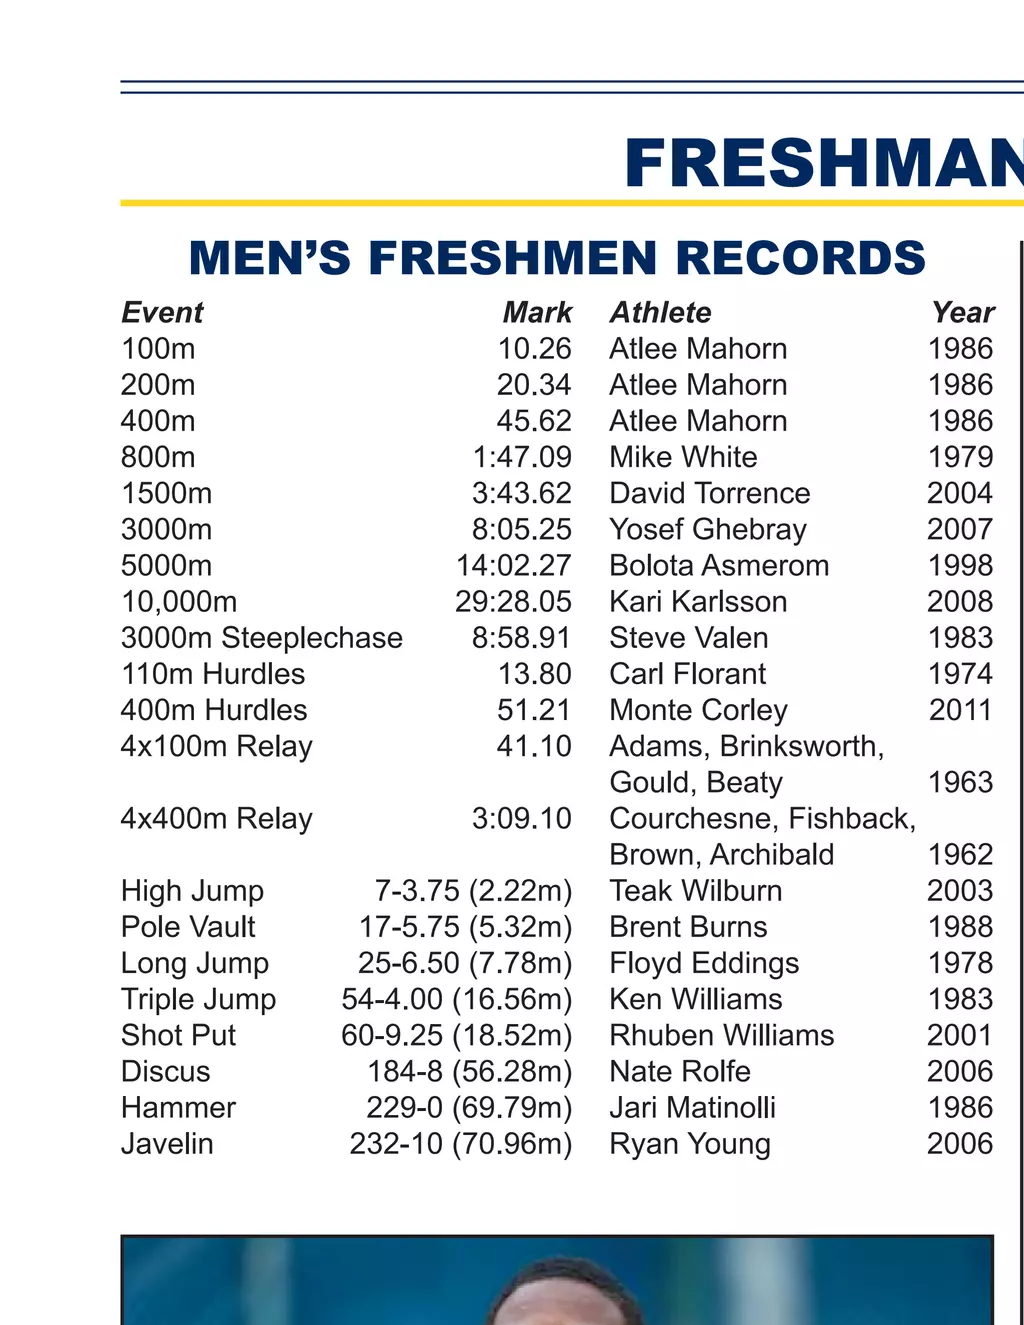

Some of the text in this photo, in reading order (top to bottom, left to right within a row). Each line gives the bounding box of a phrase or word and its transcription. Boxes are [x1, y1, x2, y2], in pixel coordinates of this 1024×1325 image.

[191, 240, 925, 275] MEN’S FRESHMEN RECORDS
[122, 301, 996, 323] Event Mark Athlete Year
[124, 337, 993, 359] 100m 10.26 Atlee Mahorn 1986
[122, 517, 993, 546] 3000m 8:05.25 Yosef Ghebray 2007
[124, 662, 993, 684] 110m Hurdles 13.80 Carl Florant 1974
[123, 879, 993, 907] High Jump 7-3.75 (2.22m) Teak Wilburn 2003
[121, 1132, 993, 1160] Javelin 232-10 (70.96m) Ryan Young 2006
